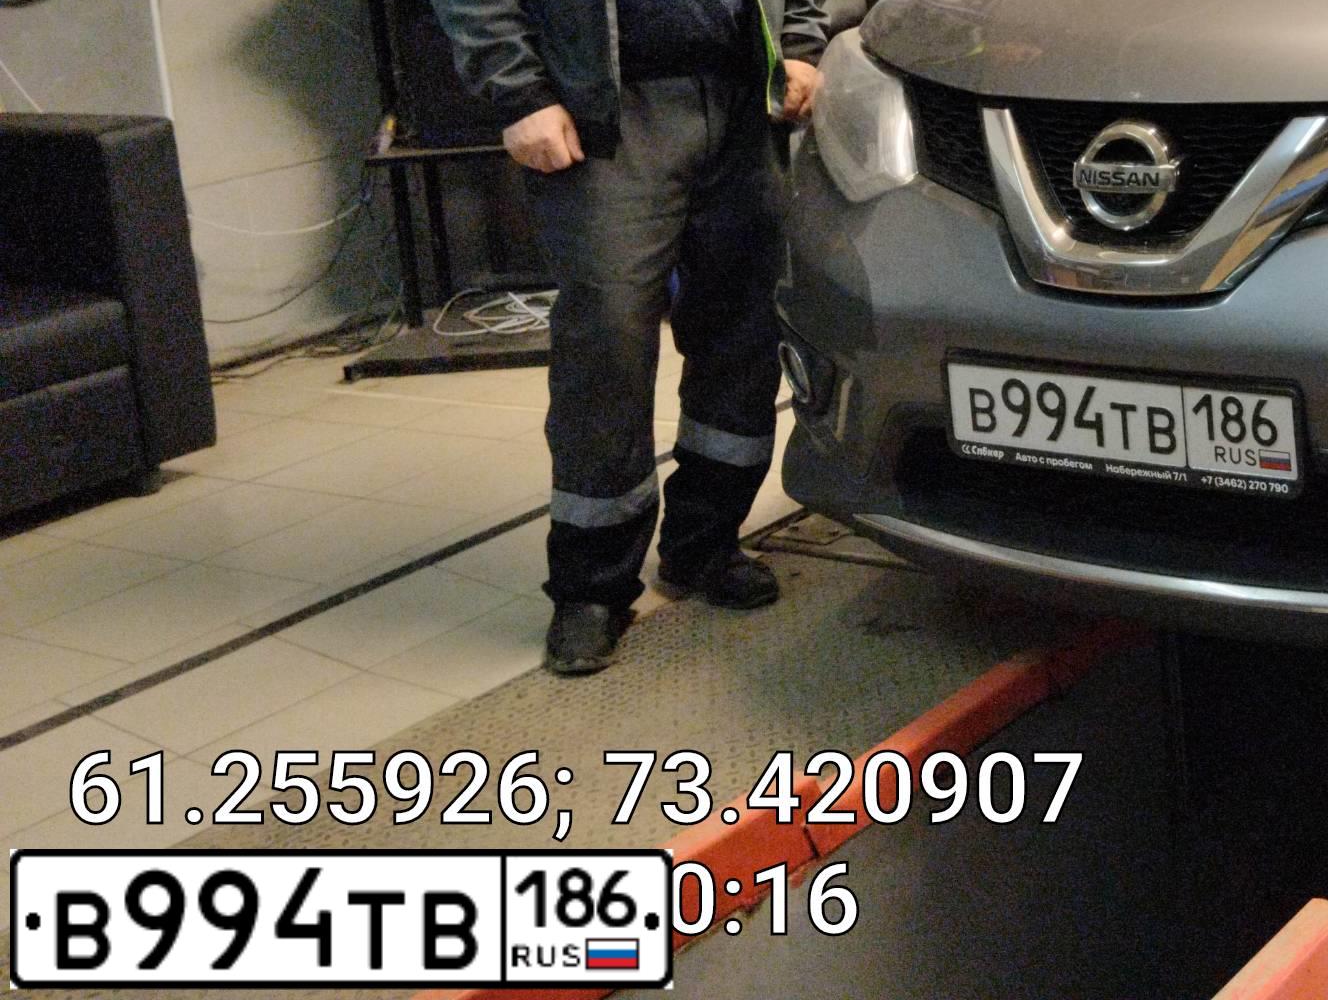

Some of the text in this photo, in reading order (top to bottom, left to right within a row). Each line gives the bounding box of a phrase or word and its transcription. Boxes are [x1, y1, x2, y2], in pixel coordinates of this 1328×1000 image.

[1080, 169, 1160, 186] NISSAN
[969, 378, 1177, 455] В994ТВ
[1192, 394, 1278, 447] 186
[1015, 452, 1038, 463] Авто
[1047, 457, 1093, 470] пробегом
[1214, 446, 1257, 466] RUS
[1201, 476, 1288, 493] +7 (3462) 270 790
